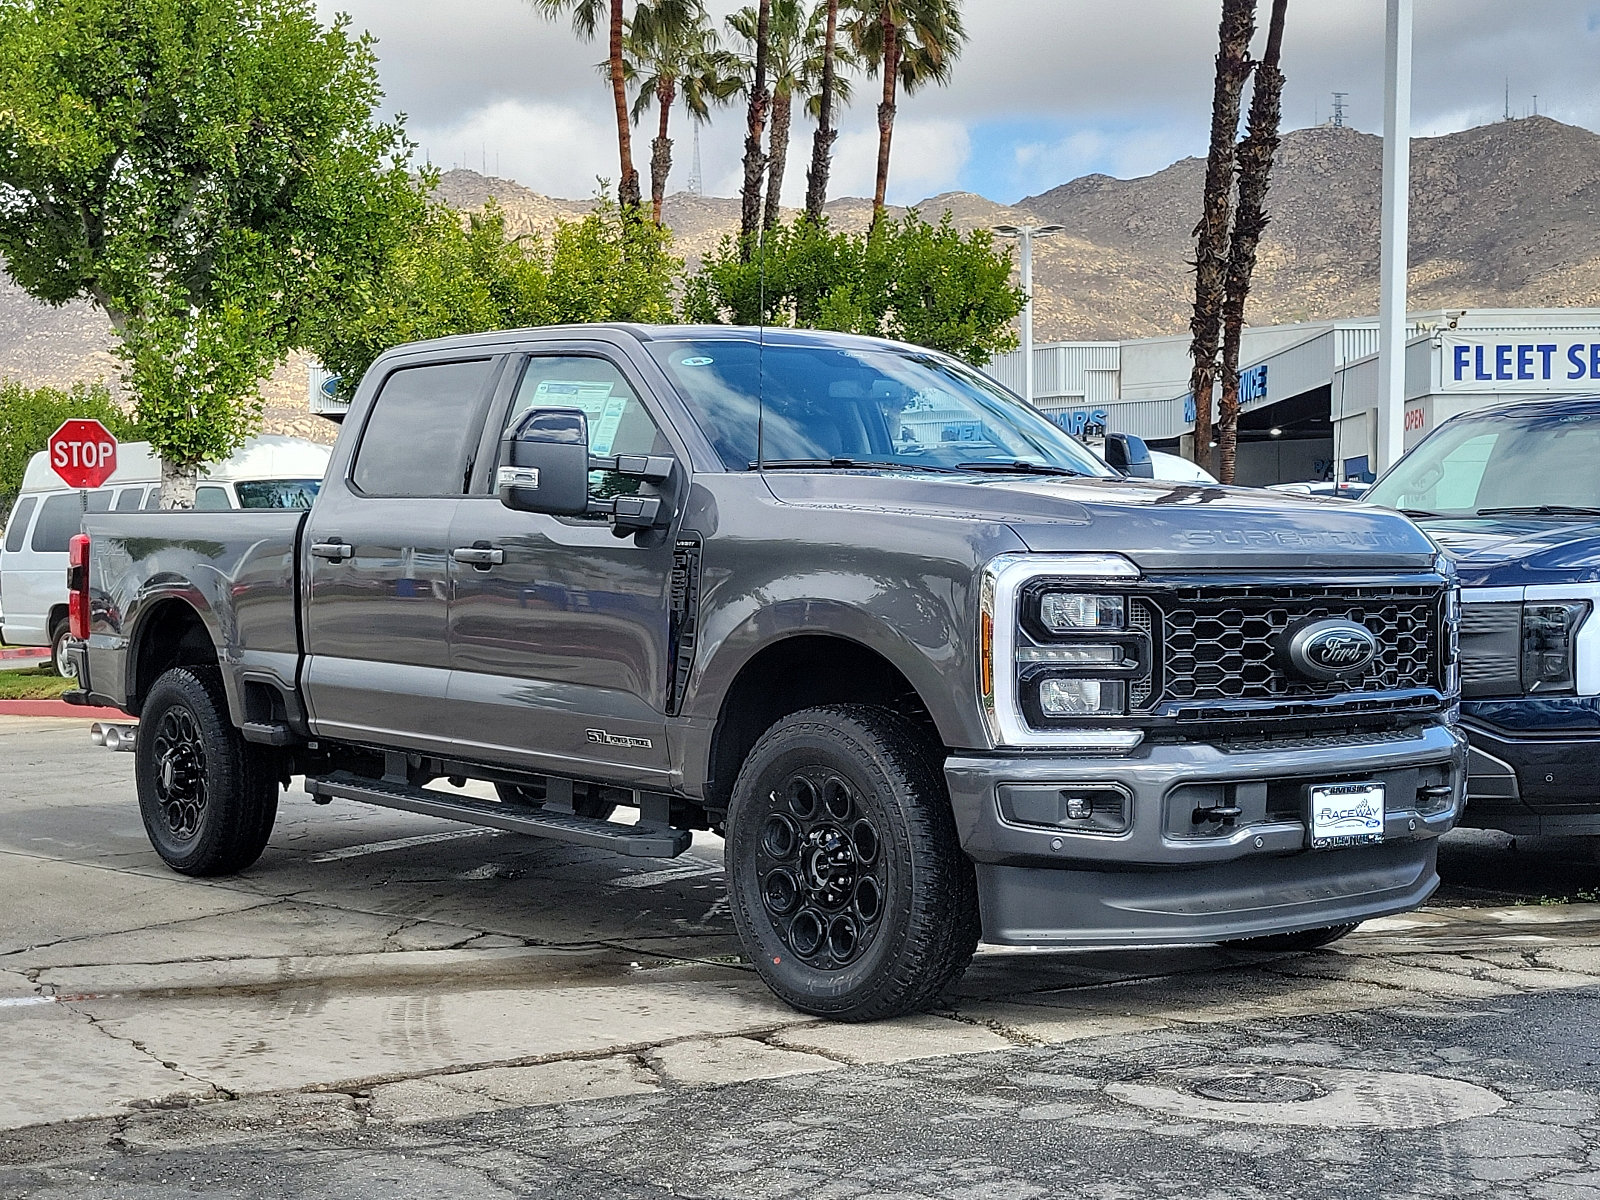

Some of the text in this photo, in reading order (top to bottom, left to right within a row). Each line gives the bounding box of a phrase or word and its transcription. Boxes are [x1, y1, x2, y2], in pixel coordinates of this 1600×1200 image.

[1453, 344, 1557, 381] FLEET
[1405, 407, 1424, 431] OPEN
[54, 440, 113, 468] STOP
[1184, 529, 1322, 547] SUPER
[1321, 636, 1361, 662] Ford
[1316, 806, 1379, 820] RACEWAY
